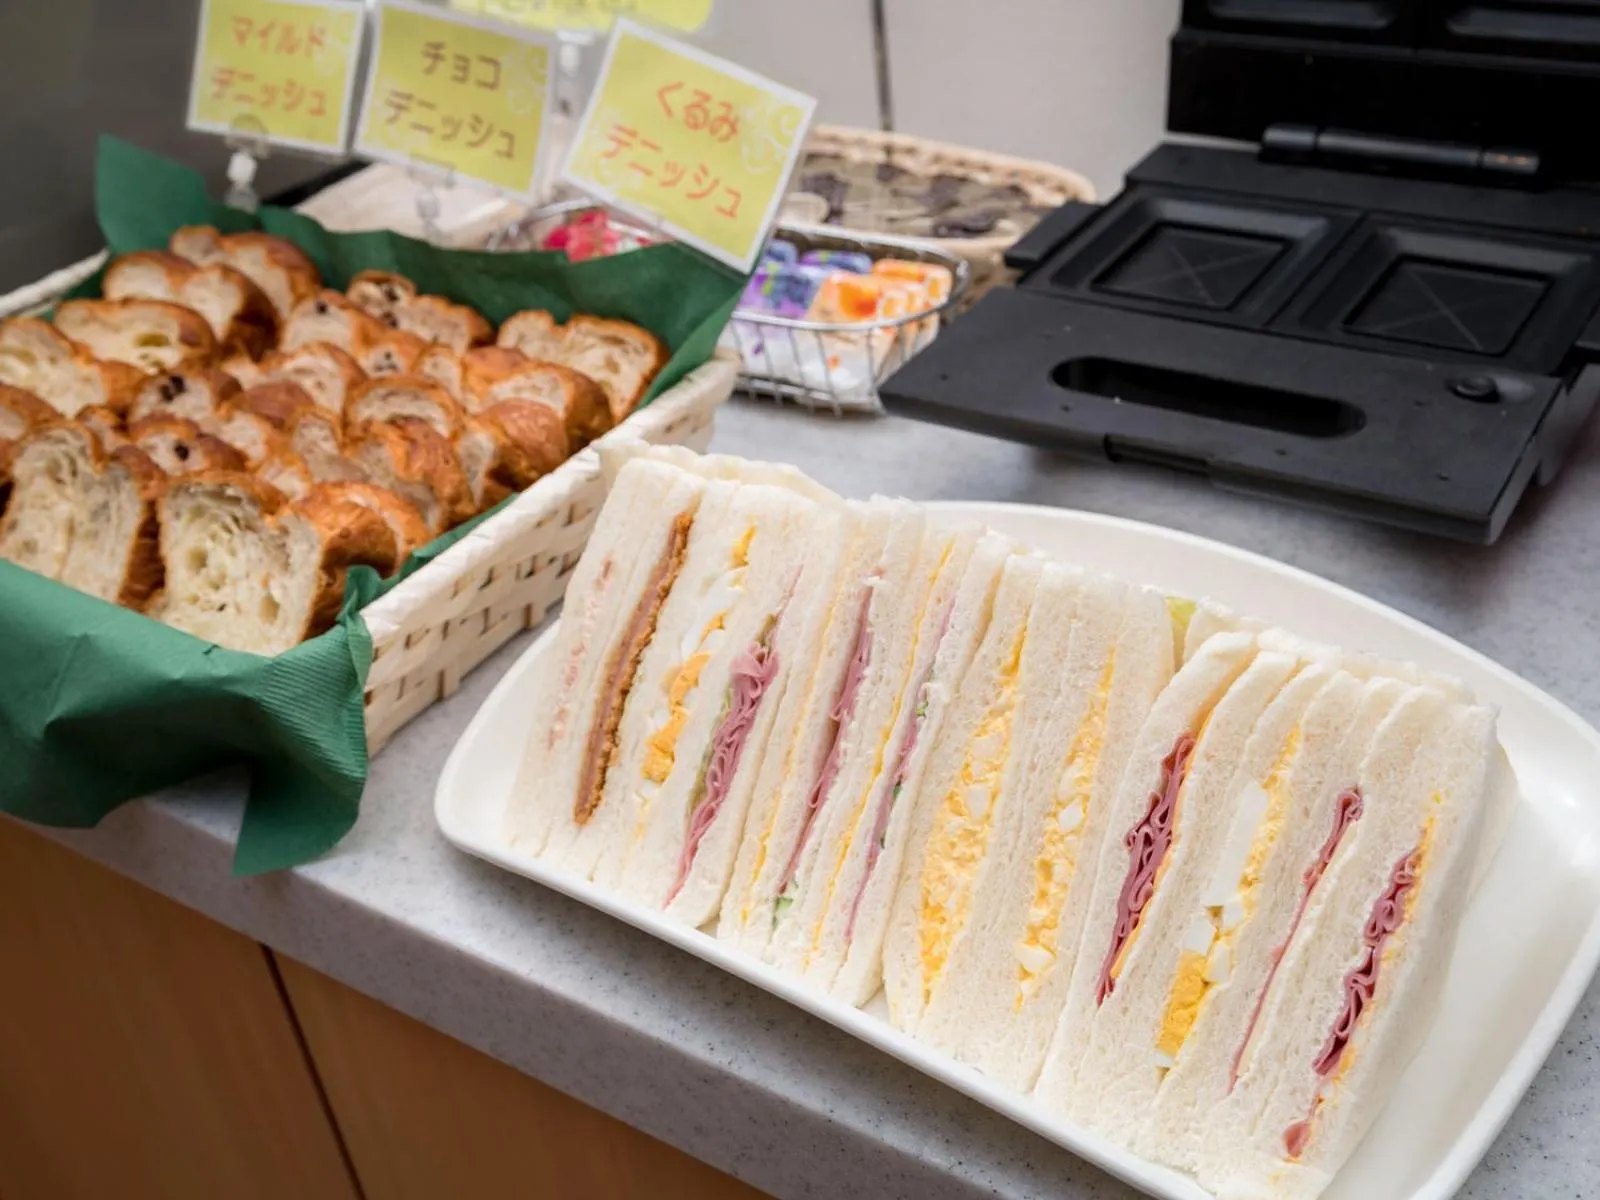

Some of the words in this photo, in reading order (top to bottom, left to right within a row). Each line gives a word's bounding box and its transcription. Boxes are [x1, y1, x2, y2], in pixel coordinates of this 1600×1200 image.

[231, 16, 327, 57] マイルド
[211, 67, 328, 117] デニッシュ
[421, 41, 503, 91] チョコ
[384, 89, 516, 160] デニッシュ
[657, 81, 740, 143] くるみ
[600, 124, 743, 219] デニッシュ
